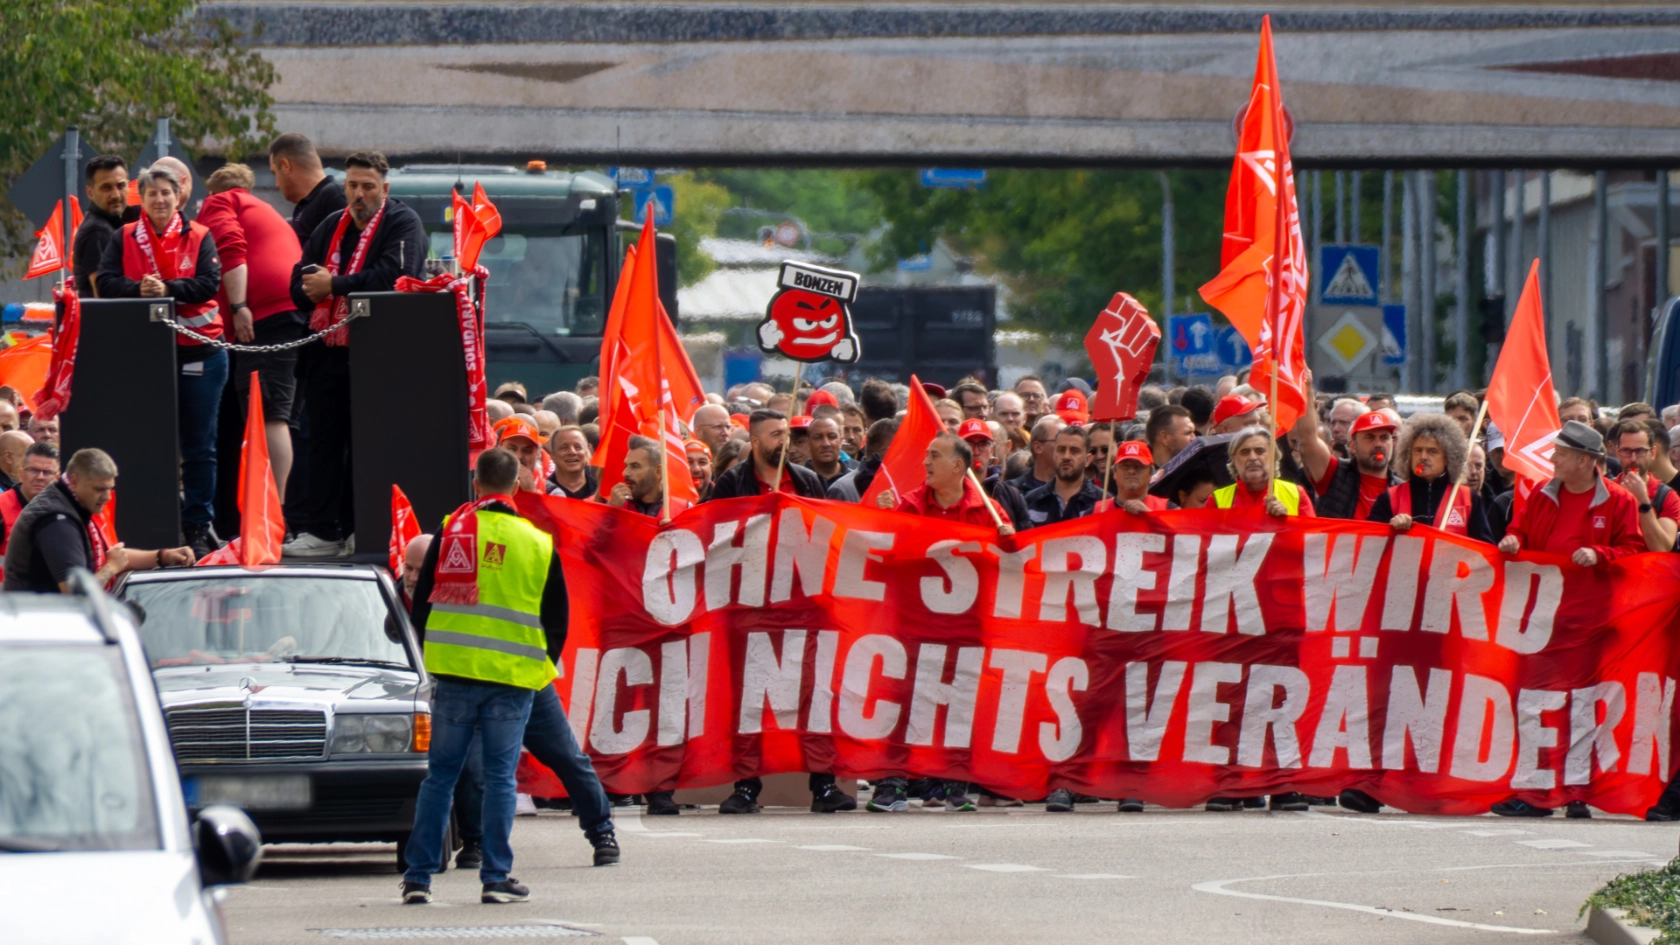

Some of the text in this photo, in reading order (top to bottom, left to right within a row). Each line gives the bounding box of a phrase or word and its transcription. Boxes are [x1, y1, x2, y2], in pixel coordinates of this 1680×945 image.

[460, 292, 477, 371] SOLIDARIT
[794, 271, 844, 296] BONZEN
[642, 507, 1564, 655] OHNE STREIK WIRD
[556, 628, 1676, 789] ICH NICHTS VERÄNDERN
